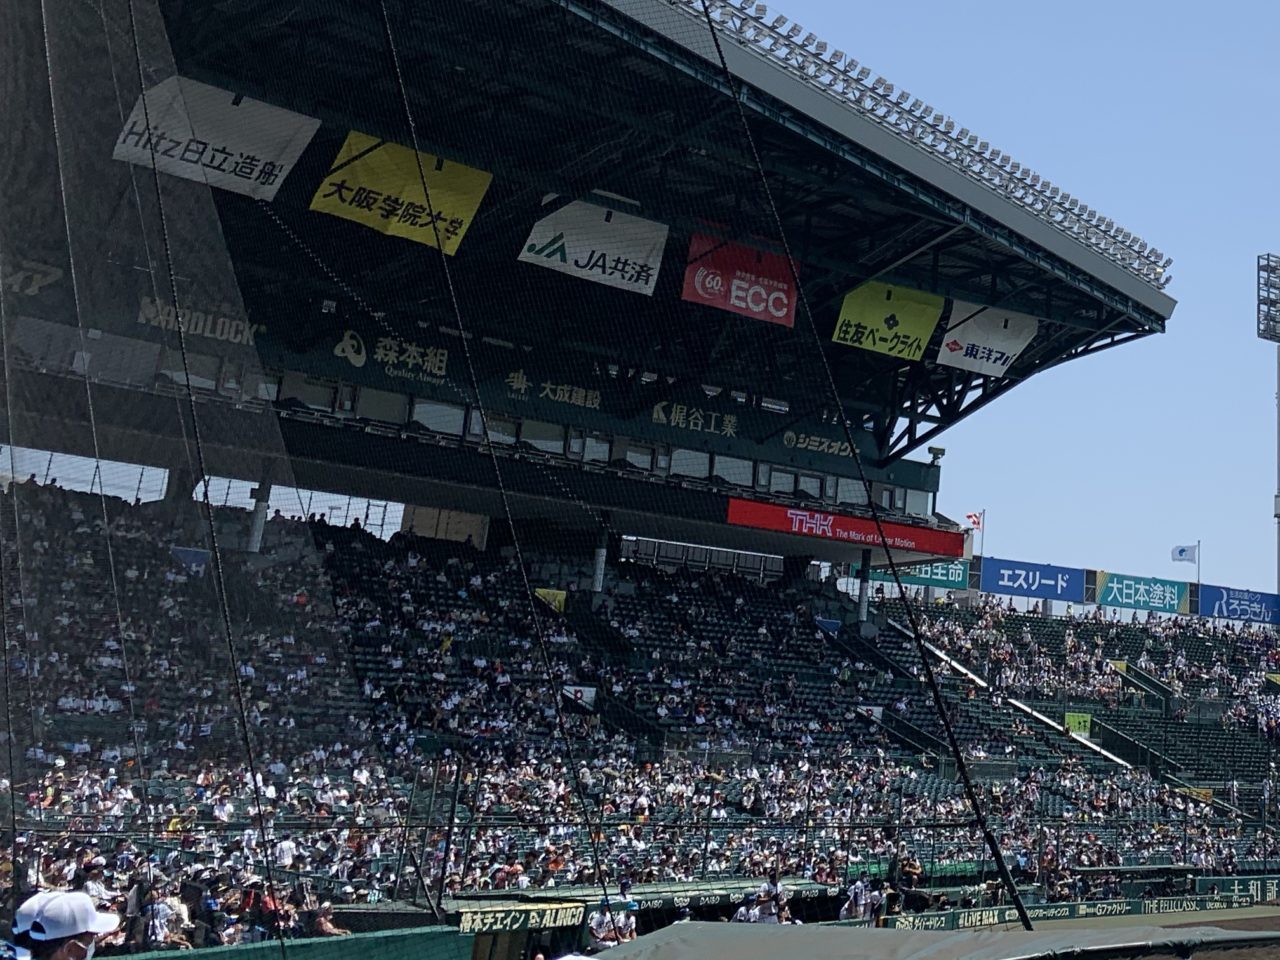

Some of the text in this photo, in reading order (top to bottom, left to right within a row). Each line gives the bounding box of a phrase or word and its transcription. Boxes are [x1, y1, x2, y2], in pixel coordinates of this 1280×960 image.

[322, 179, 465, 241] 大阪学院大学
[574, 250, 653, 286] JA共済
[730, 279, 788, 317] ECC
[838, 318, 922, 359] 住友ベークライト
[373, 337, 448, 376] 森本組
[539, 381, 600, 410] 大成建設
[670, 402, 737, 438] 梶谷工業
[787, 509, 833, 537] THK
[836, 528, 848, 538] The
[849, 530, 865, 541] Mark
[866, 533, 873, 542] of
[894, 537, 915, 548] Motion
[998, 568, 1069, 594] エスリード
[1107, 577, 1178, 609] 大日本塗料
[1229, 599, 1271, 621] ろうきん
[541, 907, 585, 928] ALINCO
[1145, 900, 1158, 913] THE
